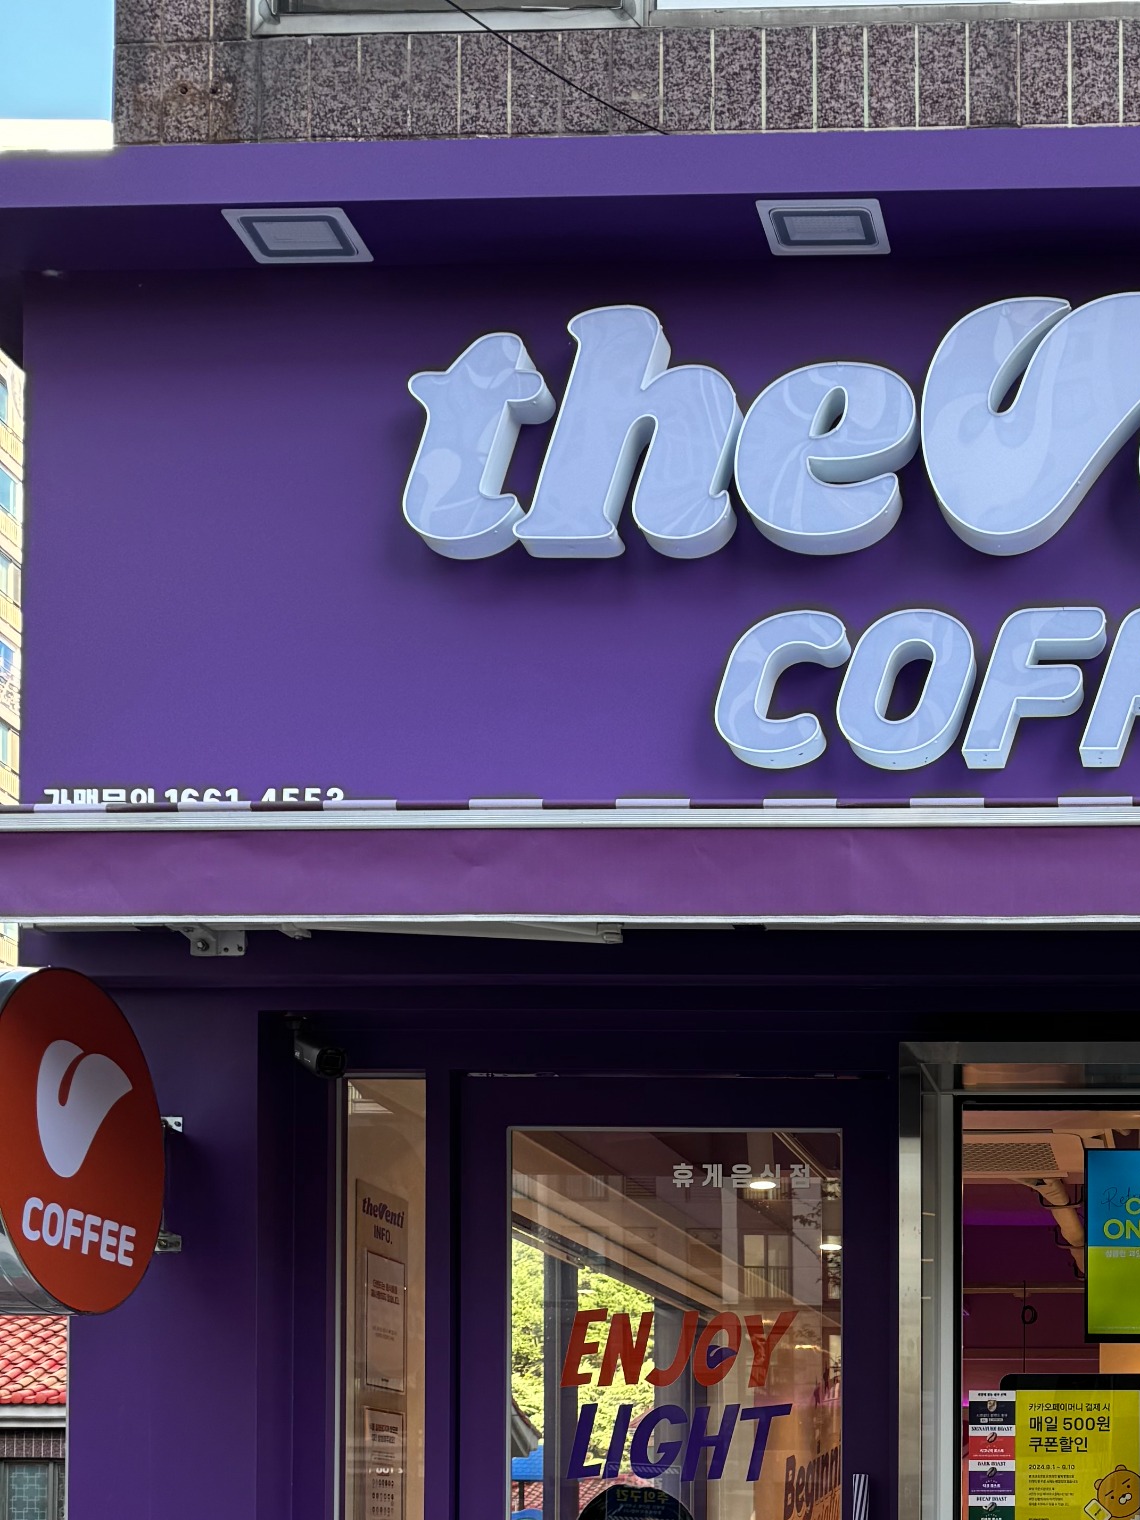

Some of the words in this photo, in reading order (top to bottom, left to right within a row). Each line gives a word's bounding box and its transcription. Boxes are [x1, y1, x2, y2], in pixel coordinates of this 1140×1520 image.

[22, 1197, 137, 1267] COFFEE
[373, 1224, 393, 1245] INFO.
[560, 1307, 799, 1389] ENJOY
[1028, 1402, 1083, 1412] 카카오페이머니
[1084, 1402, 1101, 1412] 결제
[1102, 1402, 1111, 1412] 시
[1029, 1415, 1059, 1432] 매일
[1062, 1415, 1111, 1432] 500원
[566, 1402, 793, 1483] LIGHT
[1028, 1436, 1089, 1453] 쿠폰할인
